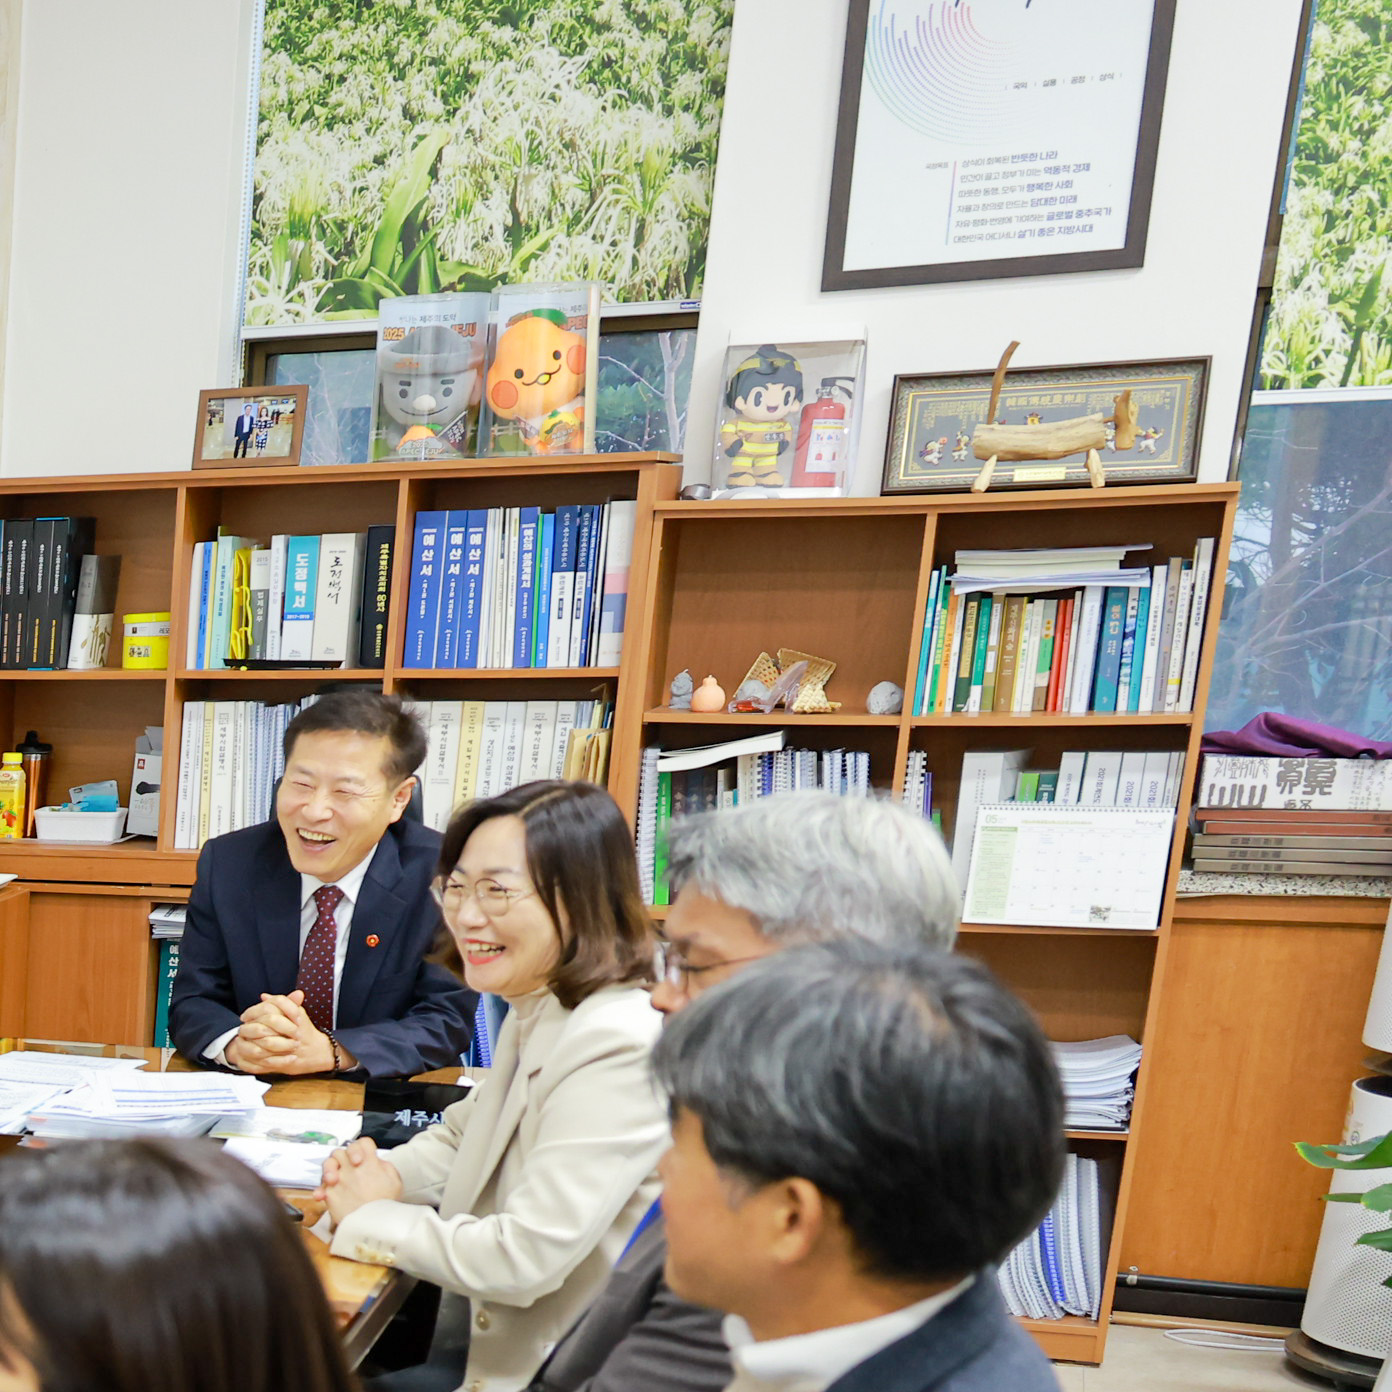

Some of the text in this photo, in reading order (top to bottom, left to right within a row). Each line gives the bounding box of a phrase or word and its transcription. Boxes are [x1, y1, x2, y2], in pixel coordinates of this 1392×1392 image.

[961, 158, 985, 168] 상식이
[1011, 152, 1038, 164] 반듯한
[1039, 150, 1058, 160] 나라
[1026, 167, 1042, 177] 미는
[1043, 164, 1071, 175] 역동적
[1073, 162, 1091, 173] 경제
[1026, 181, 1054, 193] 행복한
[1055, 179, 1073, 189] 사회
[1005, 200, 1029, 209] 만드는
[1030, 196, 1057, 208] 담대한
[1059, 194, 1078, 205] 미래
[1046, 210, 1074, 221] 글로벌
[1075, 207, 1112, 219] 중추국가
[953, 223, 1094, 243] 대한민국 어디서나 살기 좋은 지방시대
[420, 534, 435, 576] 예산서
[447, 532, 464, 575] 예산서
[467, 533, 483, 575] 예산서
[292, 553, 310, 609] 도정백서
[394, 1108, 446, 1128] 제주시
